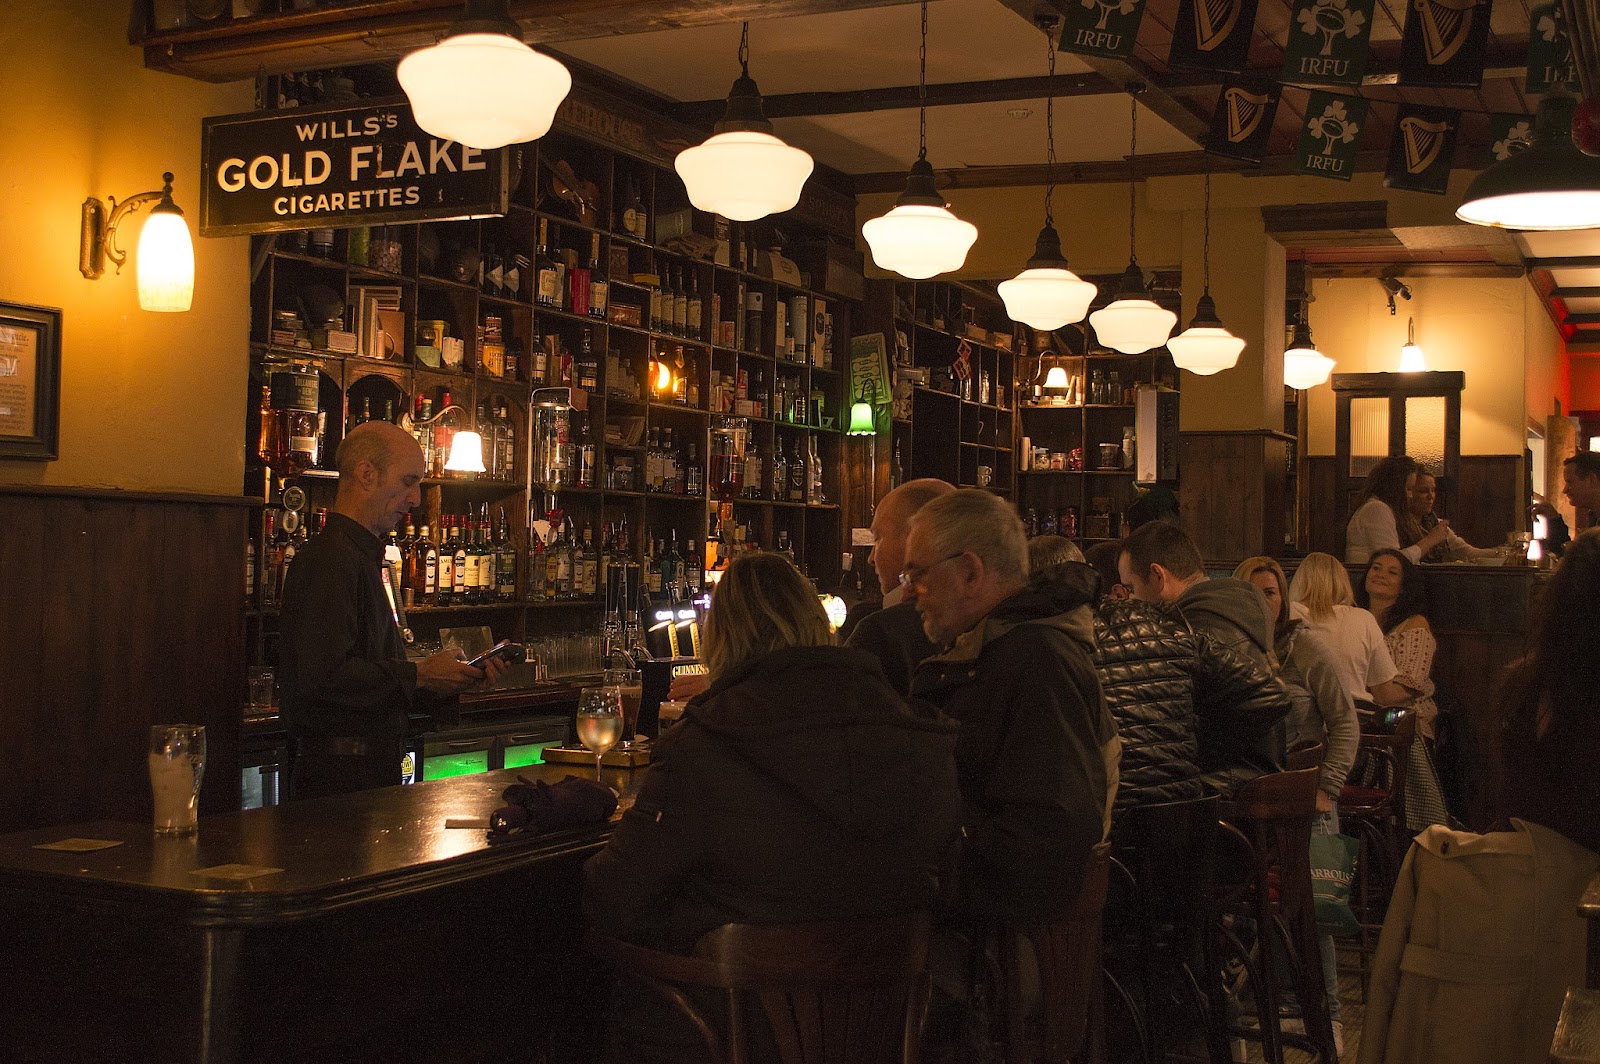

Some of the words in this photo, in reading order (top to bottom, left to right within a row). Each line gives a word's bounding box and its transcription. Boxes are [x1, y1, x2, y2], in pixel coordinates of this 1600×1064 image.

[1074, 29, 1122, 50] IRFU
[1299, 57, 1349, 77] IRFU
[217, 150, 332, 193] GOLD
[350, 139, 487, 182] FLAKE
[1306, 154, 1345, 172] IRFU
[273, 185, 420, 216] CIGARETTES
[672, 663, 710, 678] GUINNESS
